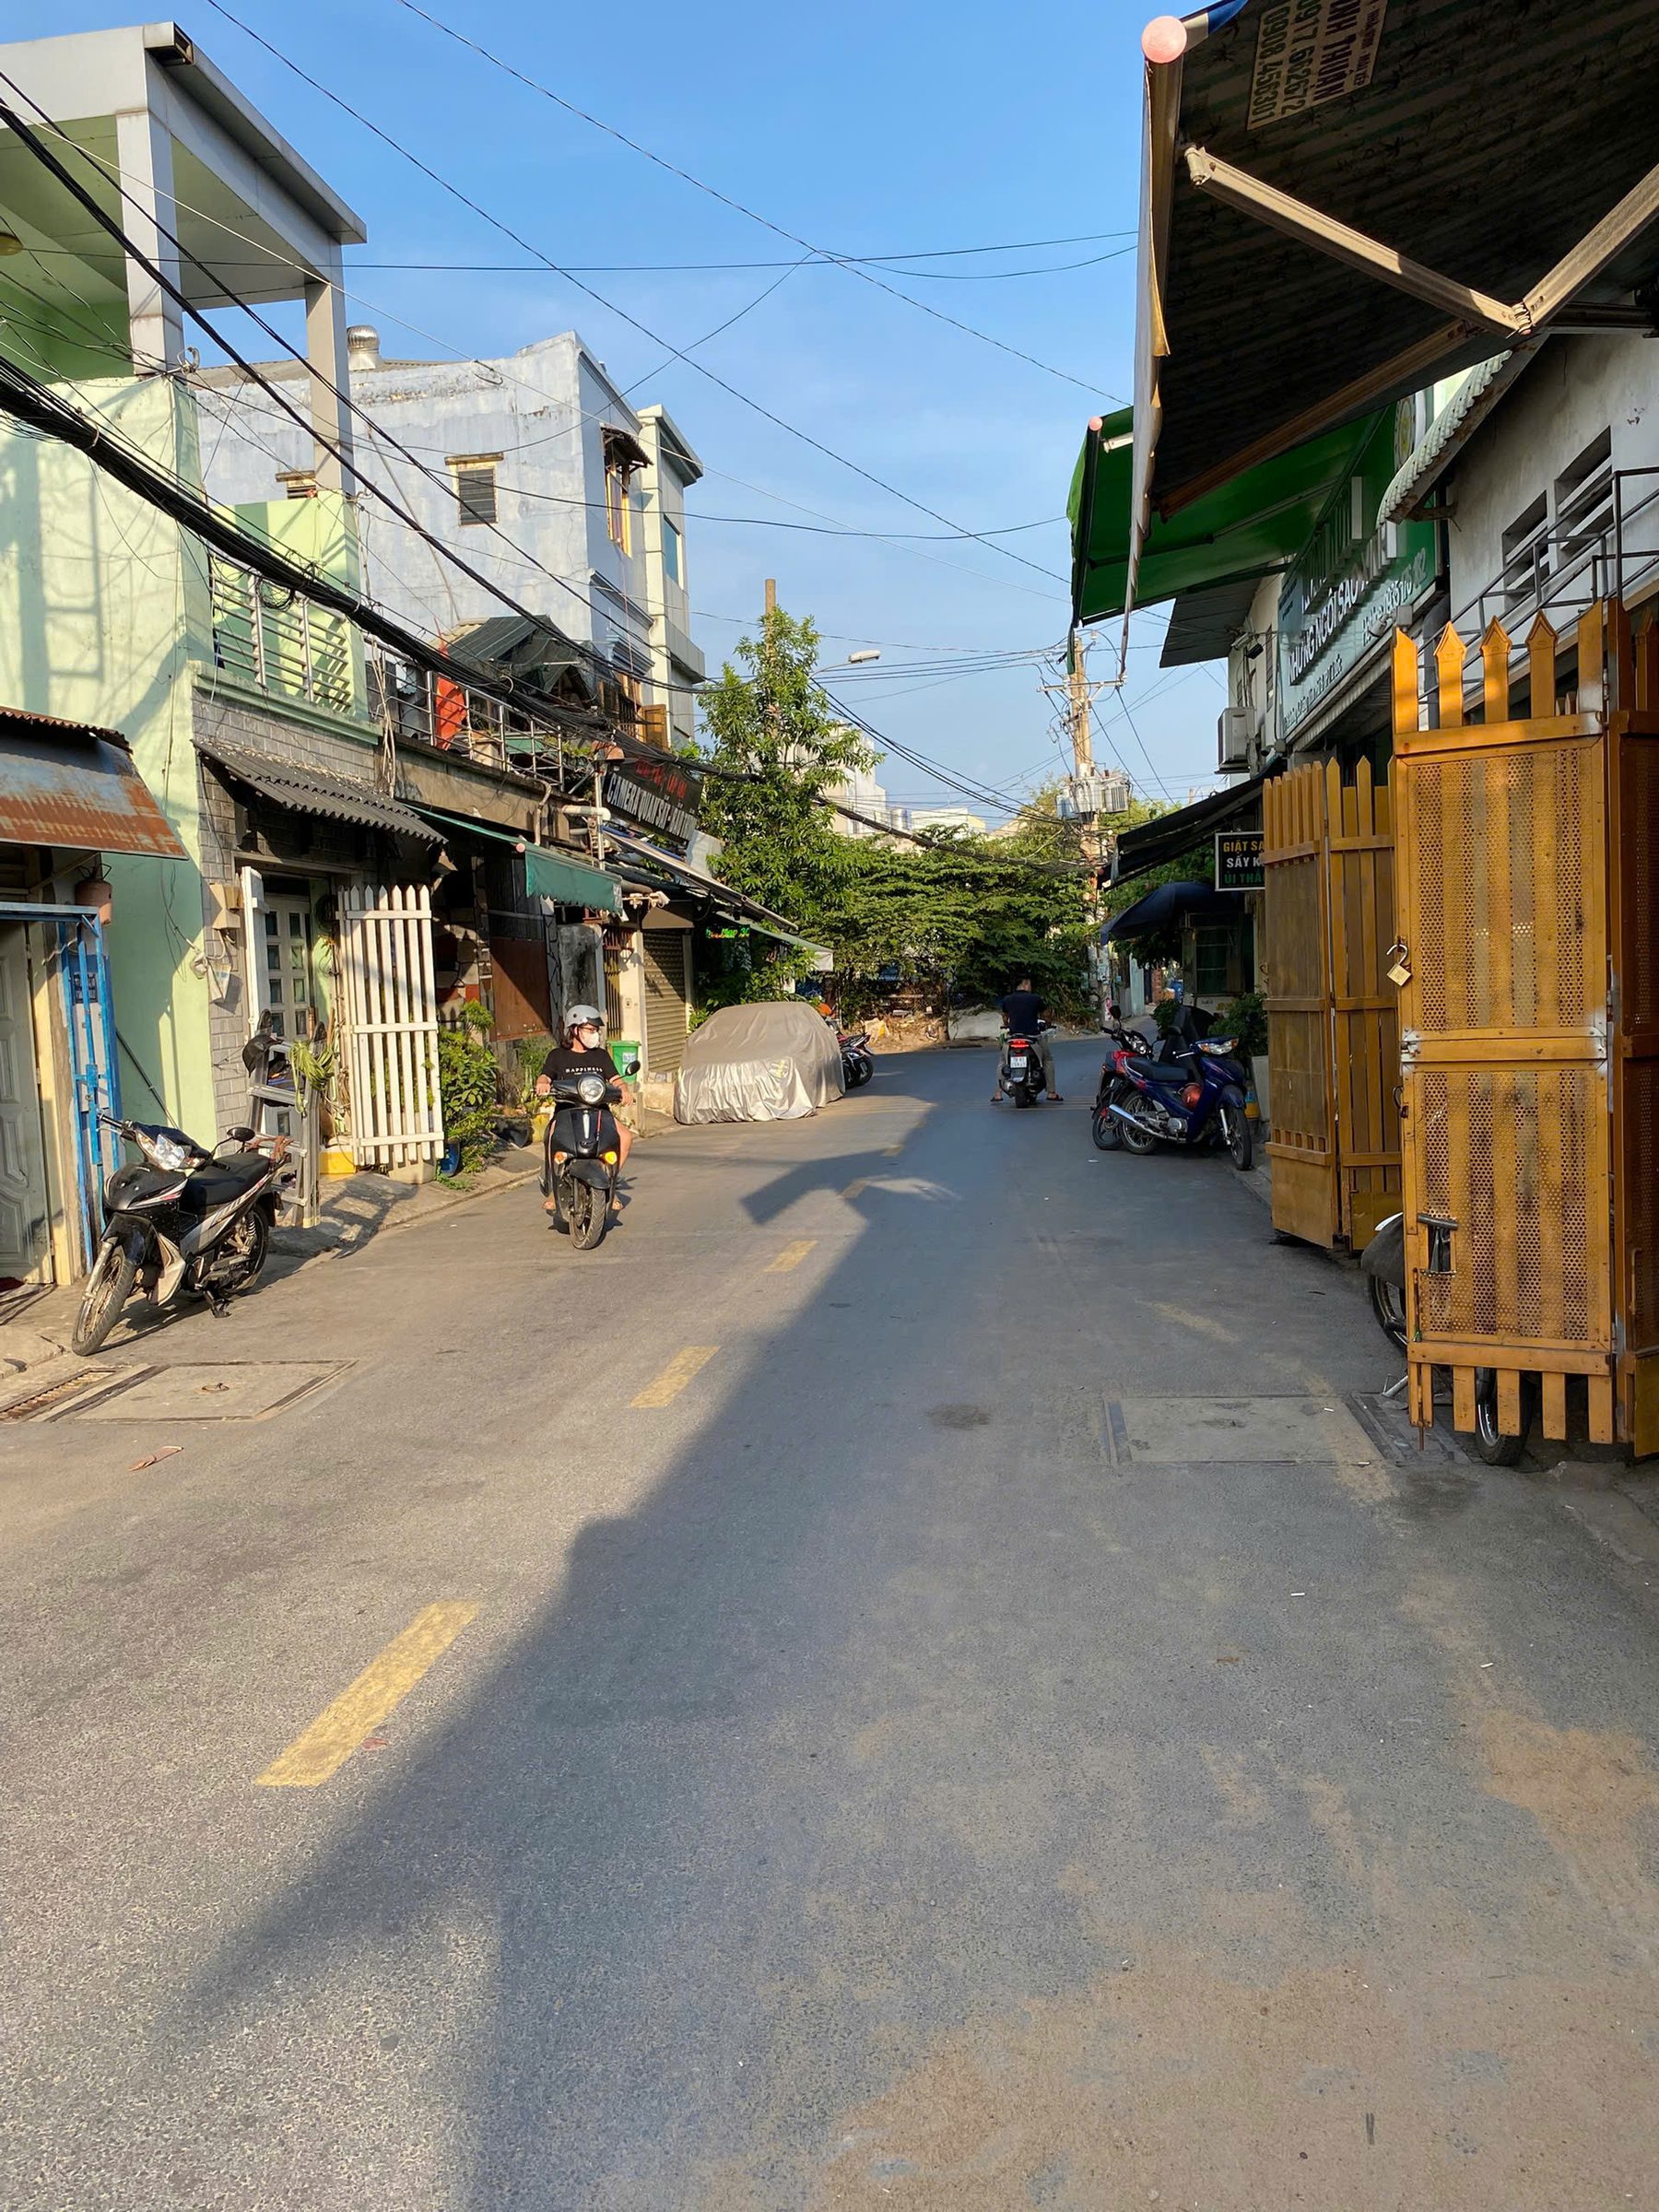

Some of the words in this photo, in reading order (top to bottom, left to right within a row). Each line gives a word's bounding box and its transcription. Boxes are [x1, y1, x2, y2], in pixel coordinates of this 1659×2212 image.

[1251, 6, 1290, 124] 0908.456301
[1310, 33, 1358, 101] THUẬN
[606, 772, 641, 816] CAMERA
[1223, 840, 1248, 854] GIẶT
[1226, 854, 1250, 868] SẤY
